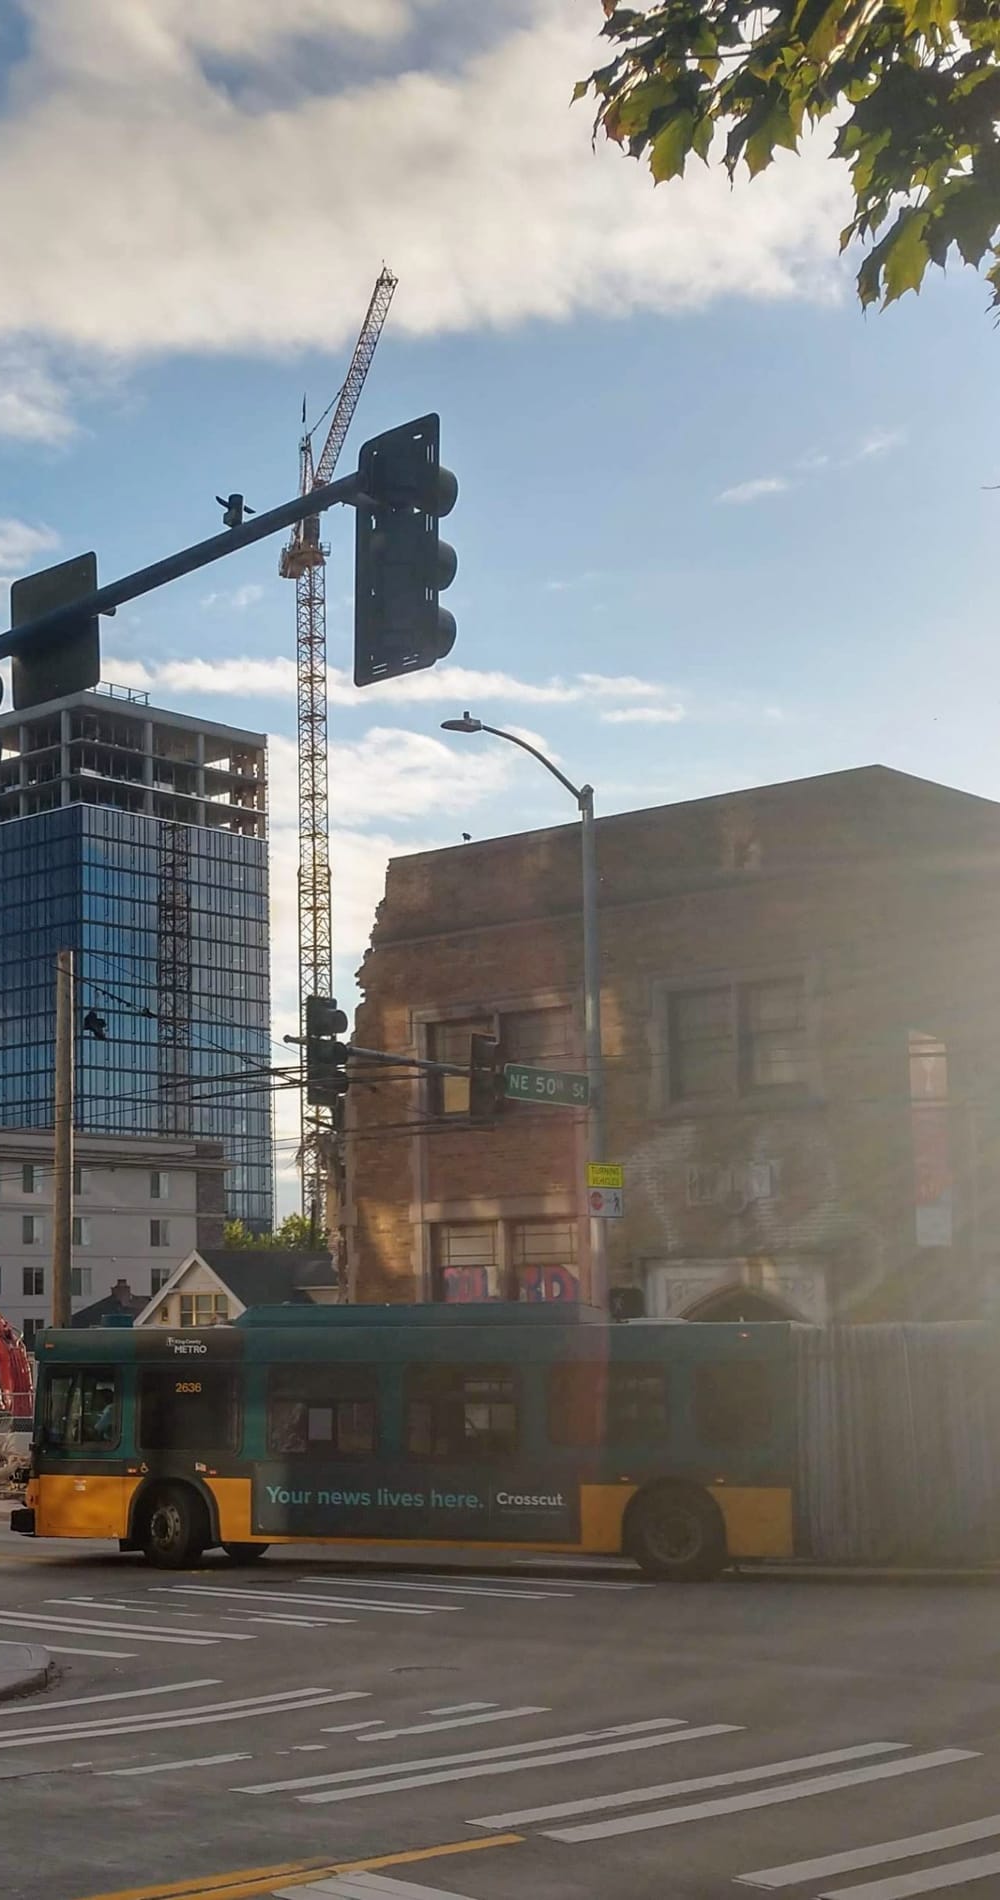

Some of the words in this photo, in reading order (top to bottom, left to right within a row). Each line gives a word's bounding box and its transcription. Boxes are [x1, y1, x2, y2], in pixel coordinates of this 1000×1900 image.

[510, 1074, 528, 1090] NE
[174, 1345, 207, 1354] METRO
[266, 1486, 312, 1504] Your
[317, 1490, 371, 1506] news
[377, 1488, 424, 1507] lives
[431, 1489, 484, 1508] here.
